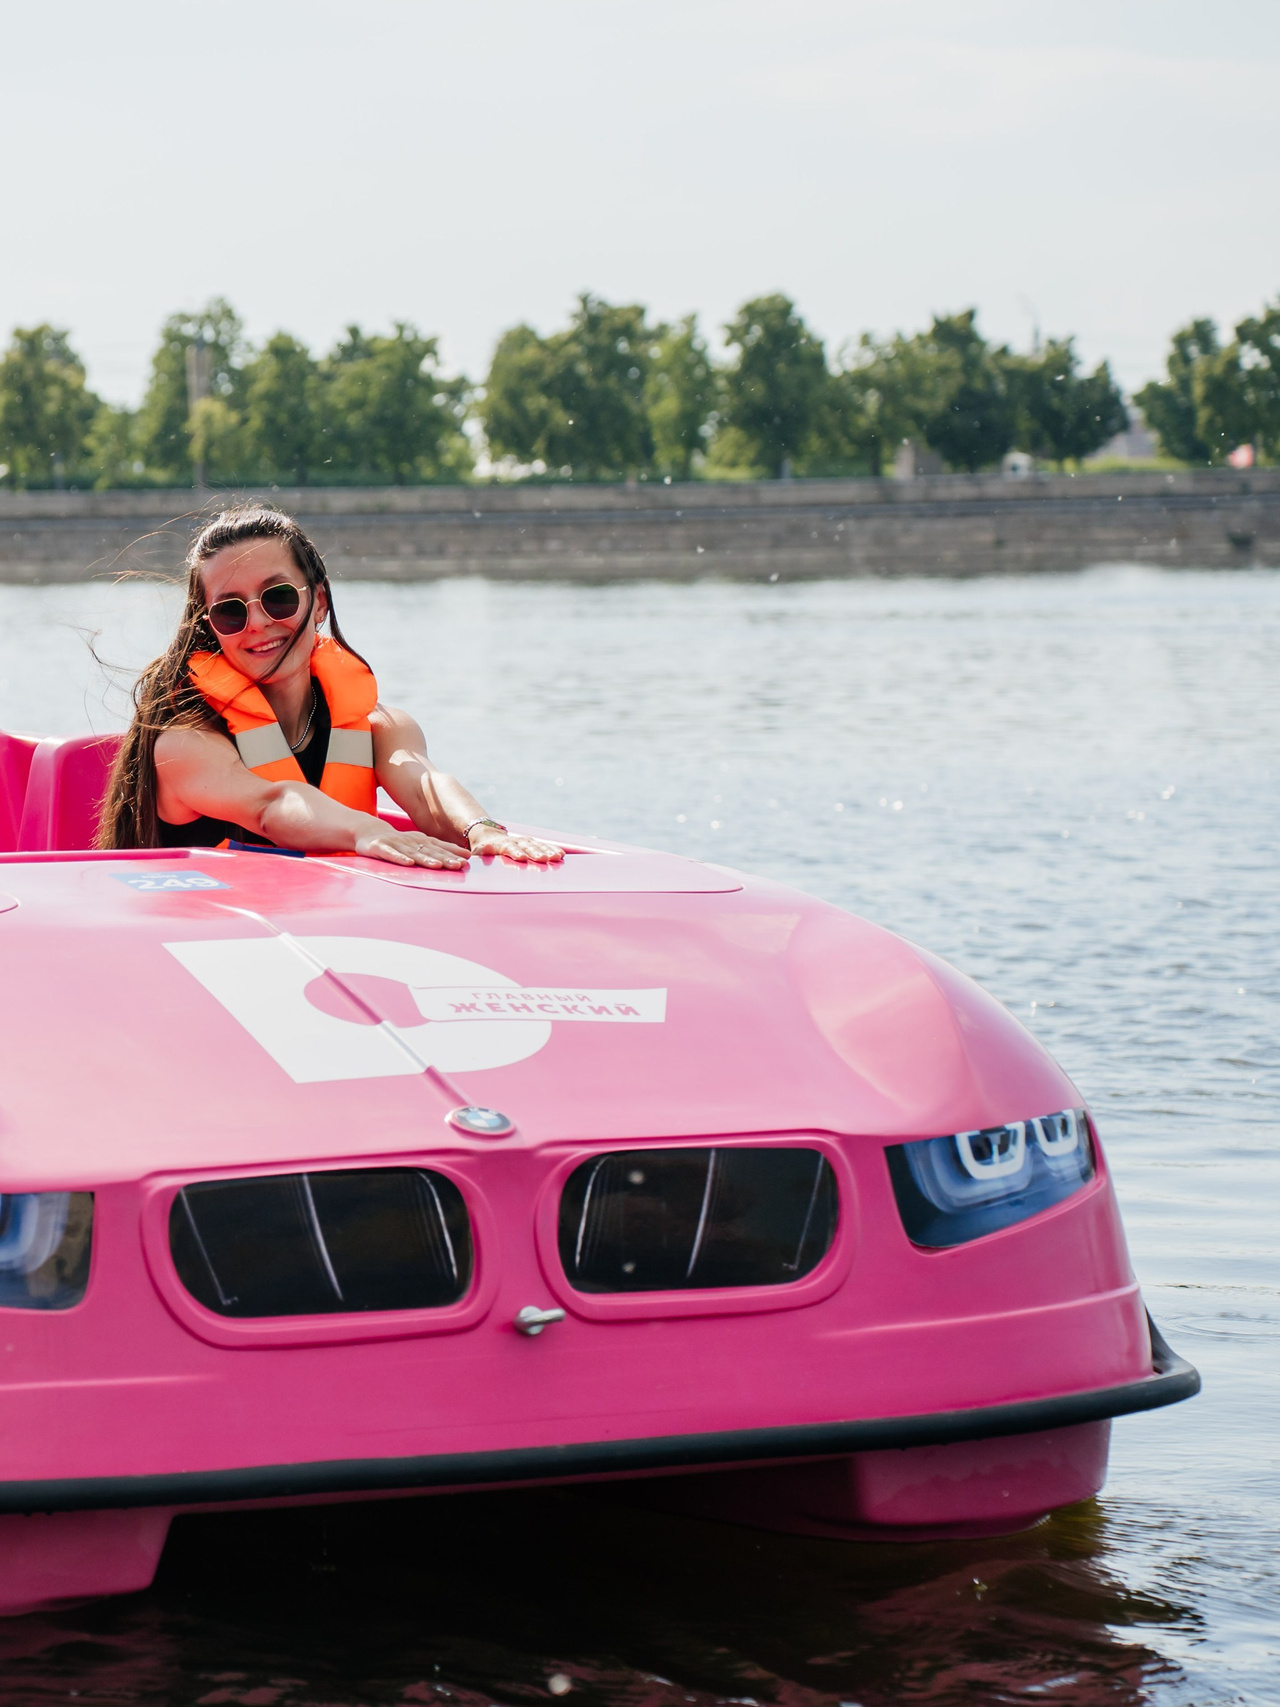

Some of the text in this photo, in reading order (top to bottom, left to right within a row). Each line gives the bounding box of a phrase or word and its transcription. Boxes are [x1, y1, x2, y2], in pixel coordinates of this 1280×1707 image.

[128, 878, 220, 890] 249
[471, 992, 592, 1003] ГЛАВНЫЙ
[448, 1002, 641, 1017] ЖЕНСКИЙ
